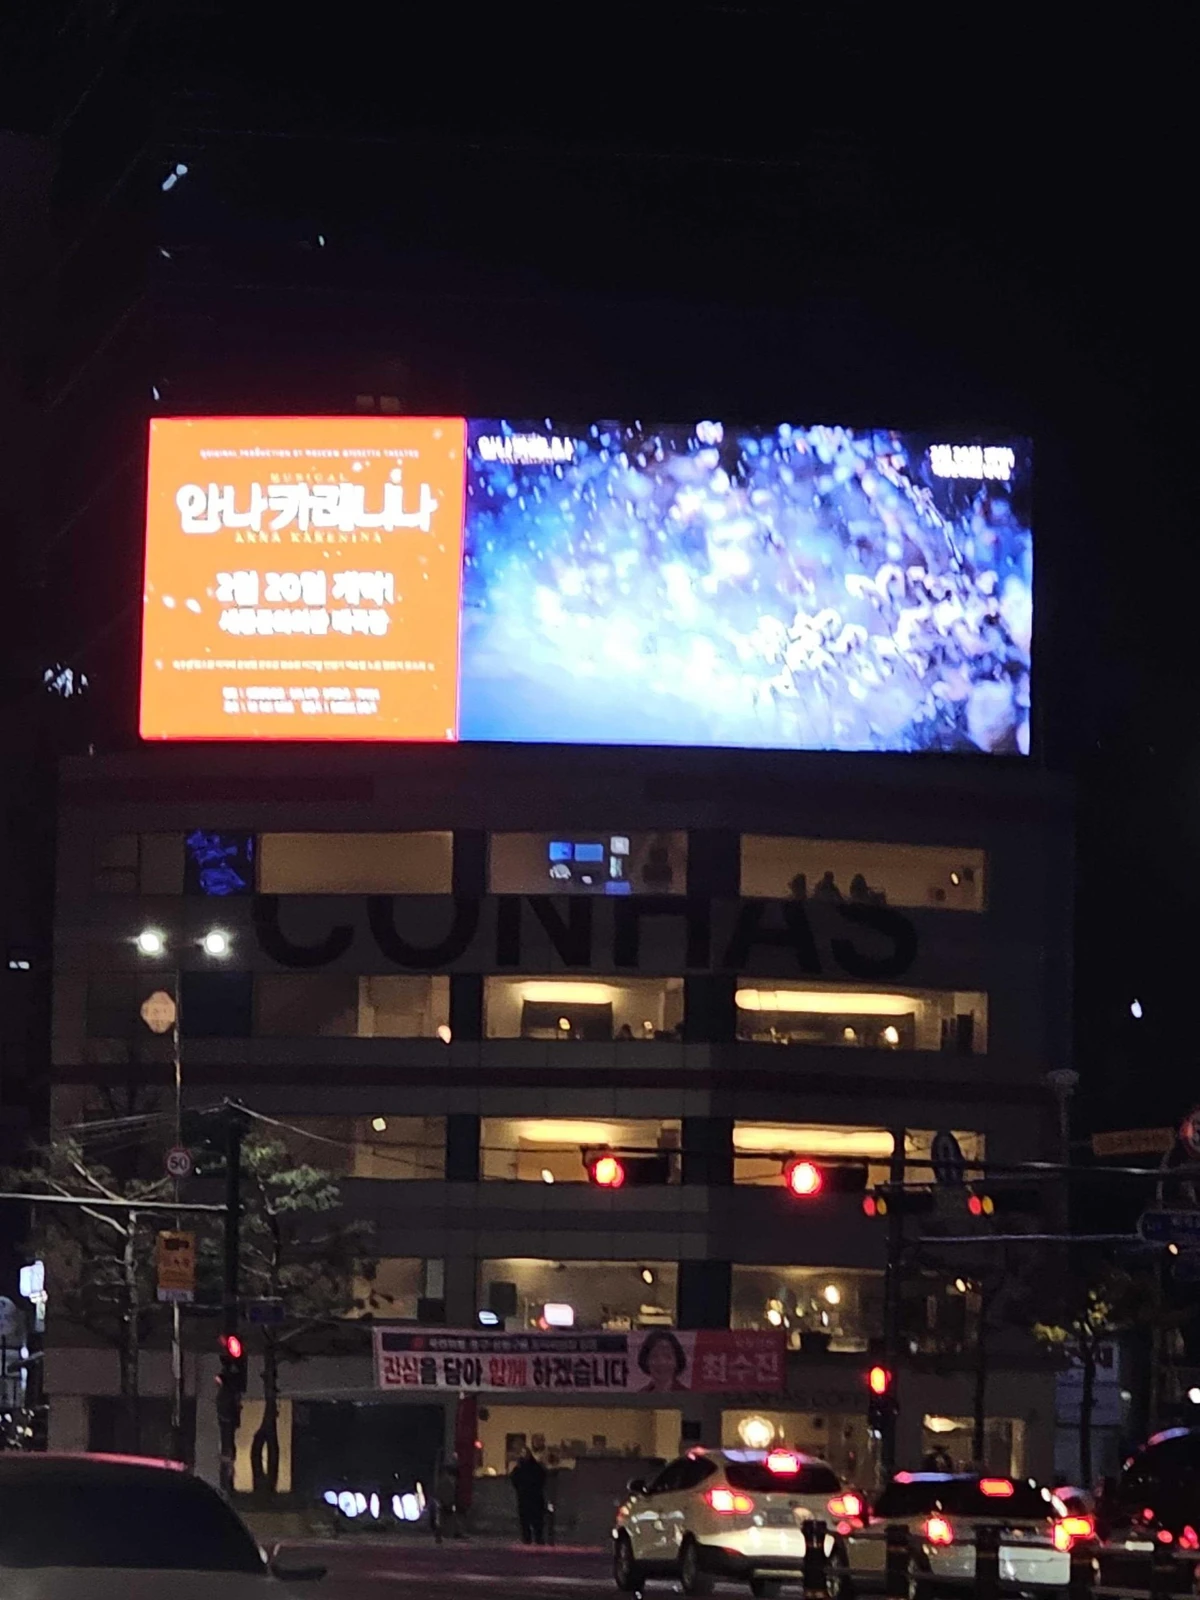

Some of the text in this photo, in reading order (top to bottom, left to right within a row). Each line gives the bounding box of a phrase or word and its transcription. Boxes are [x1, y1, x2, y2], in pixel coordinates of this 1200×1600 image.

[169, 1156, 188, 1170] 50
[383, 1356, 629, 1387] 진심을 담아 함께 하겠습니다
